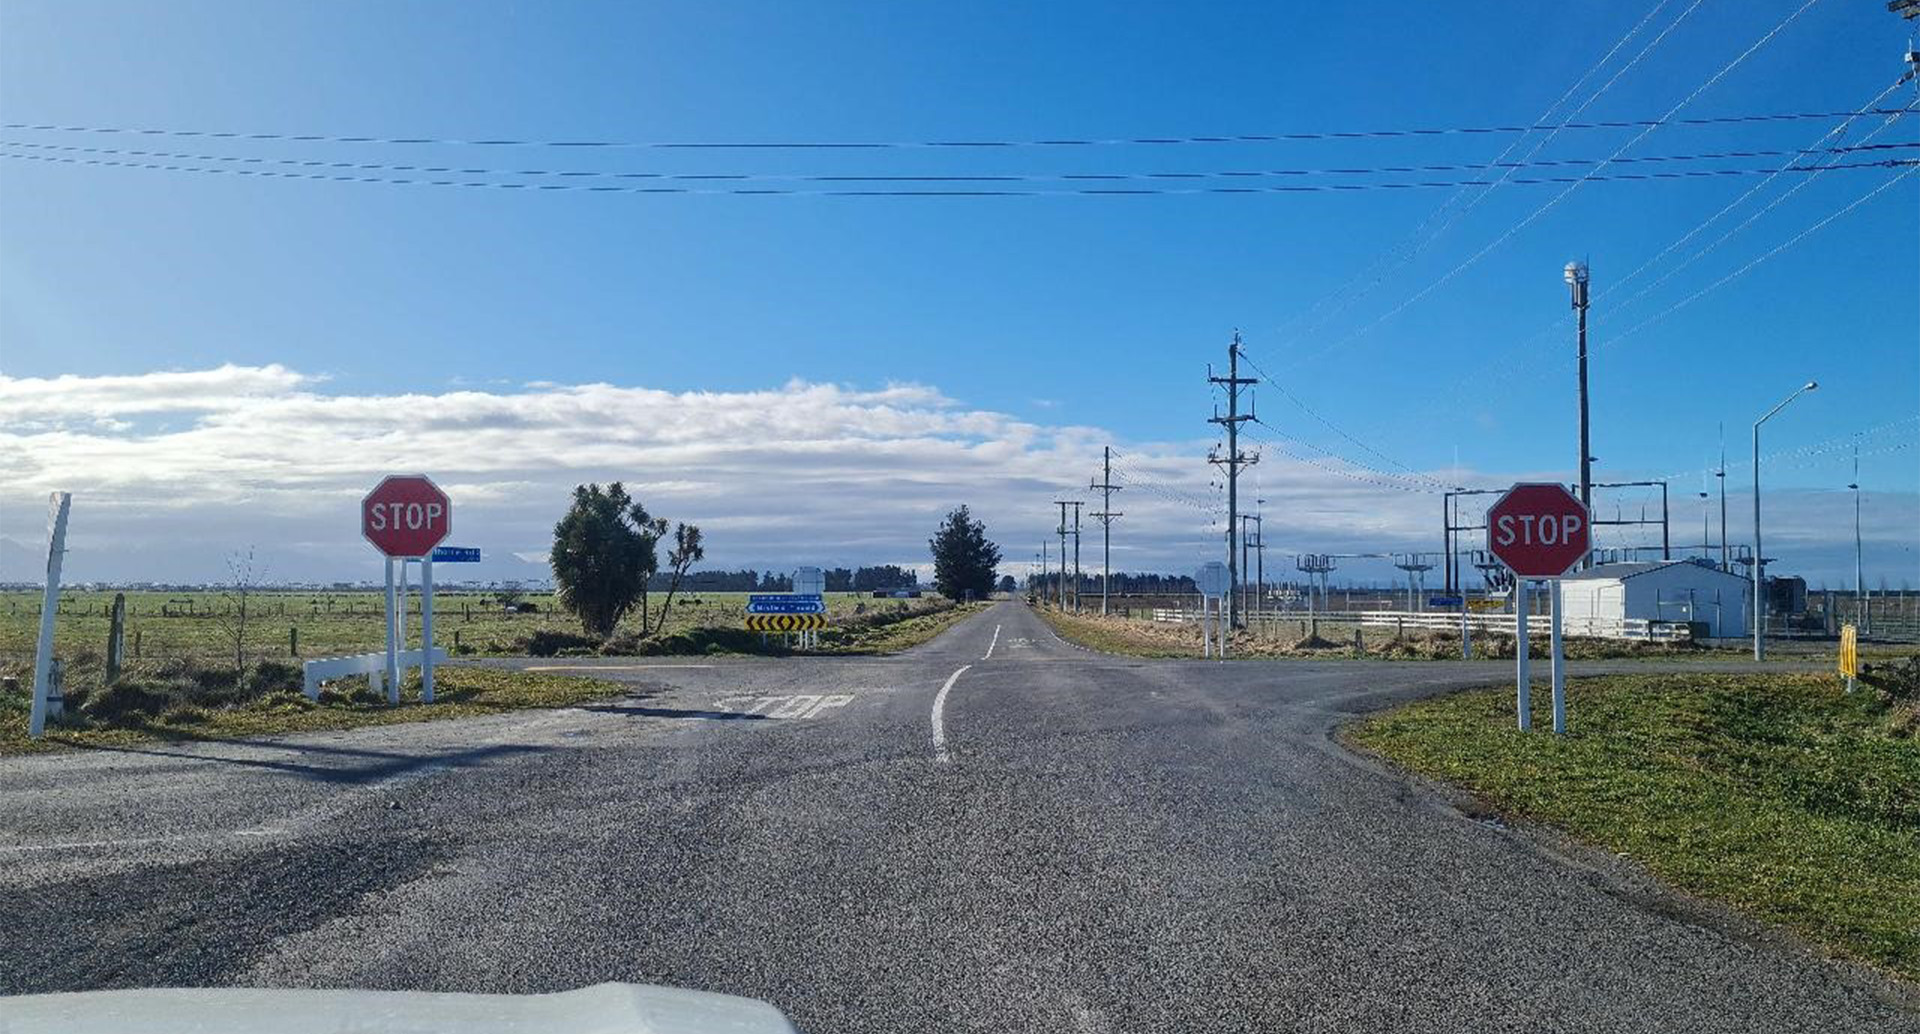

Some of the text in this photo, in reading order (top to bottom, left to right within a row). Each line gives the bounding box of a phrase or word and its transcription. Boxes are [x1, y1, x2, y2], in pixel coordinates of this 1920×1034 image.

[371, 502, 442, 531] STOP
[1496, 514, 1582, 546] STOP
[713, 693, 855, 719] STOP
